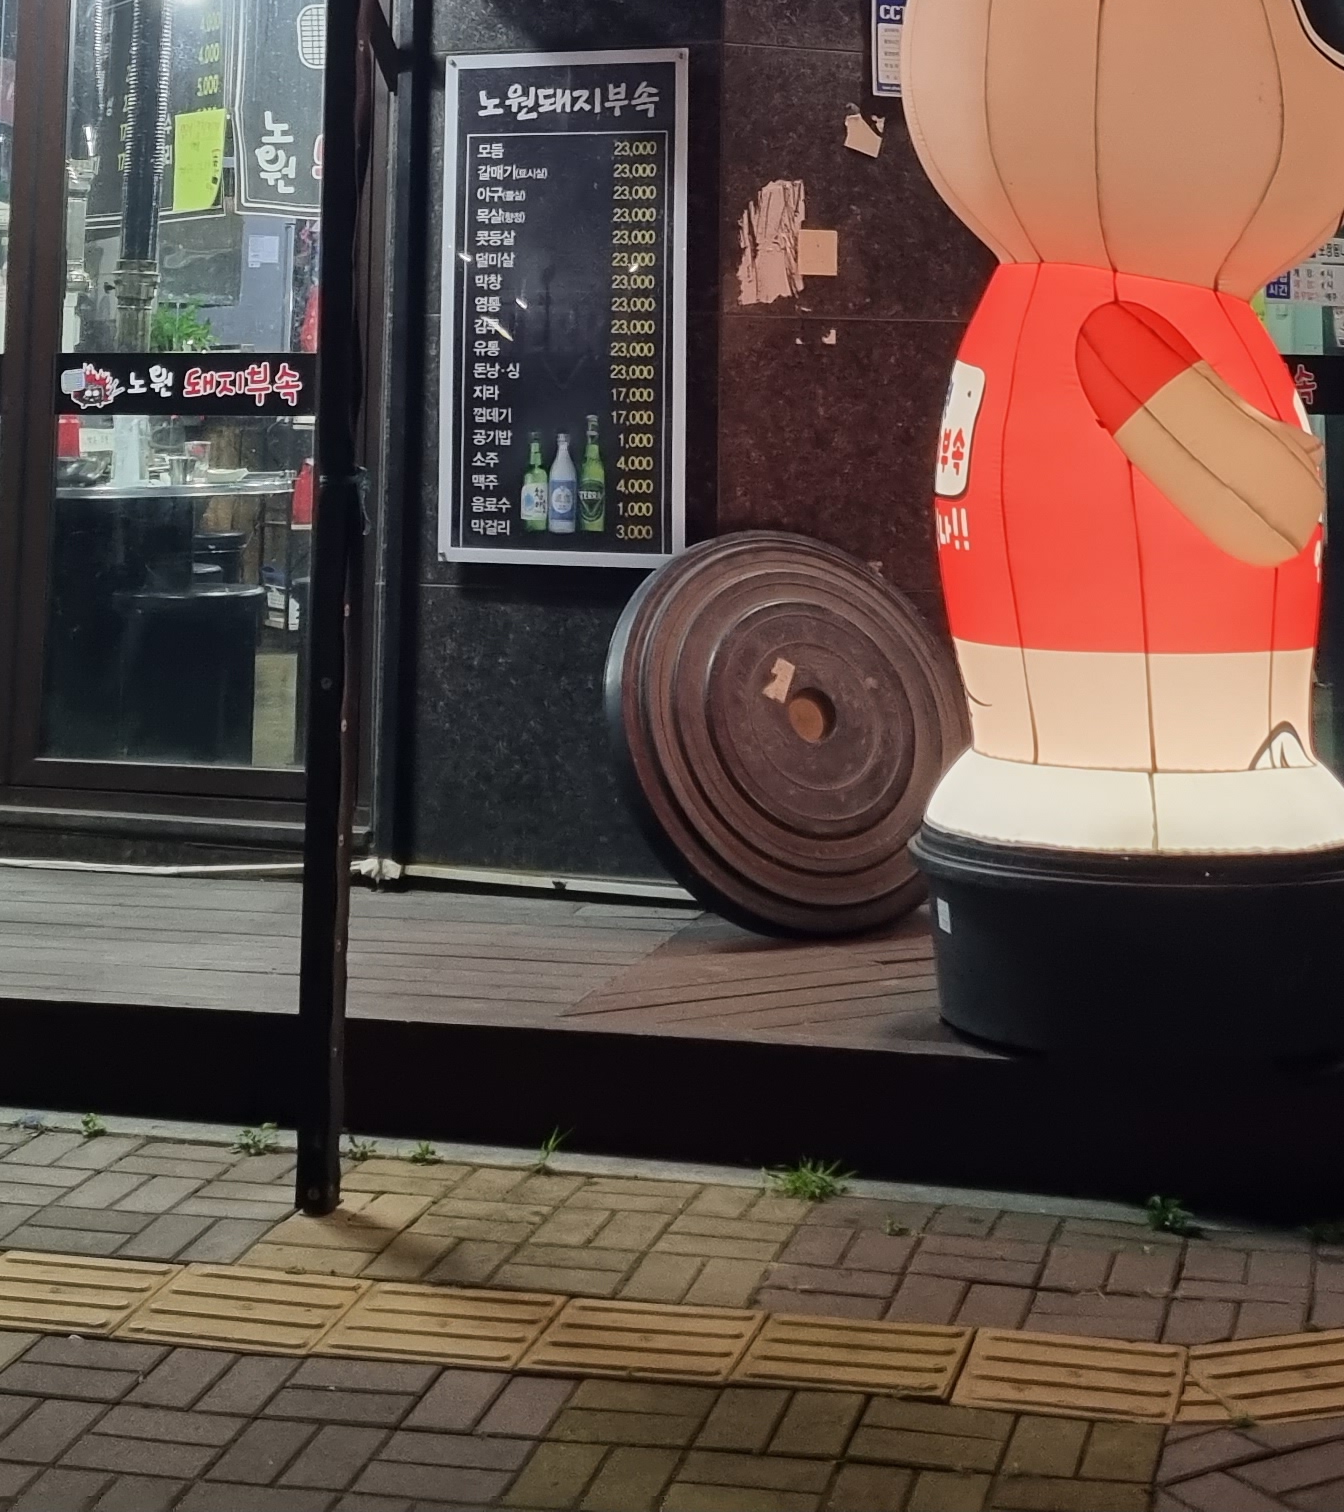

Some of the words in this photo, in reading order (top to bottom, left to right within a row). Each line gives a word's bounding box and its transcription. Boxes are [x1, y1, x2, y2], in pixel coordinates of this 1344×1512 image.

[879, 5, 907, 20] CCT
[476, 80, 660, 121] 노원돼지부속
[476, 143, 504, 159] 모듬
[614, 141, 656, 157] 23,000
[613, 163, 656, 179] 23,000
[613, 185, 656, 201] 23,000
[612, 207, 656, 223] 23,000
[612, 229, 656, 245] 23,000
[611, 252, 655, 268] 23,000
[474, 274, 503, 291] 막창
[611, 274, 655, 291] 23,000
[611, 297, 655, 313] 23,000
[610, 319, 655, 335] 23,000
[610, 342, 654, 358] 23,000
[609, 365, 654, 381] 23,000
[181, 361, 304, 407] 돼지부속
[472, 385, 500, 401] 지라
[610, 388, 654, 404] 17,000
[472, 407, 512, 424] 껍데기
[610, 410, 654, 426] 17,000
[472, 430, 513, 446] 공기밥
[618, 433, 653, 450] 1,000
[471, 452, 499, 468] 소주
[616, 456, 653, 472] 4,000
[471, 474, 499, 491] 맥주
[616, 479, 653, 496] 4,000
[470, 496, 512, 513] 음료수
[617, 502, 653, 518] 1,000
[470, 519, 511, 536] 막걸리
[616, 525, 652, 541] 3,000
